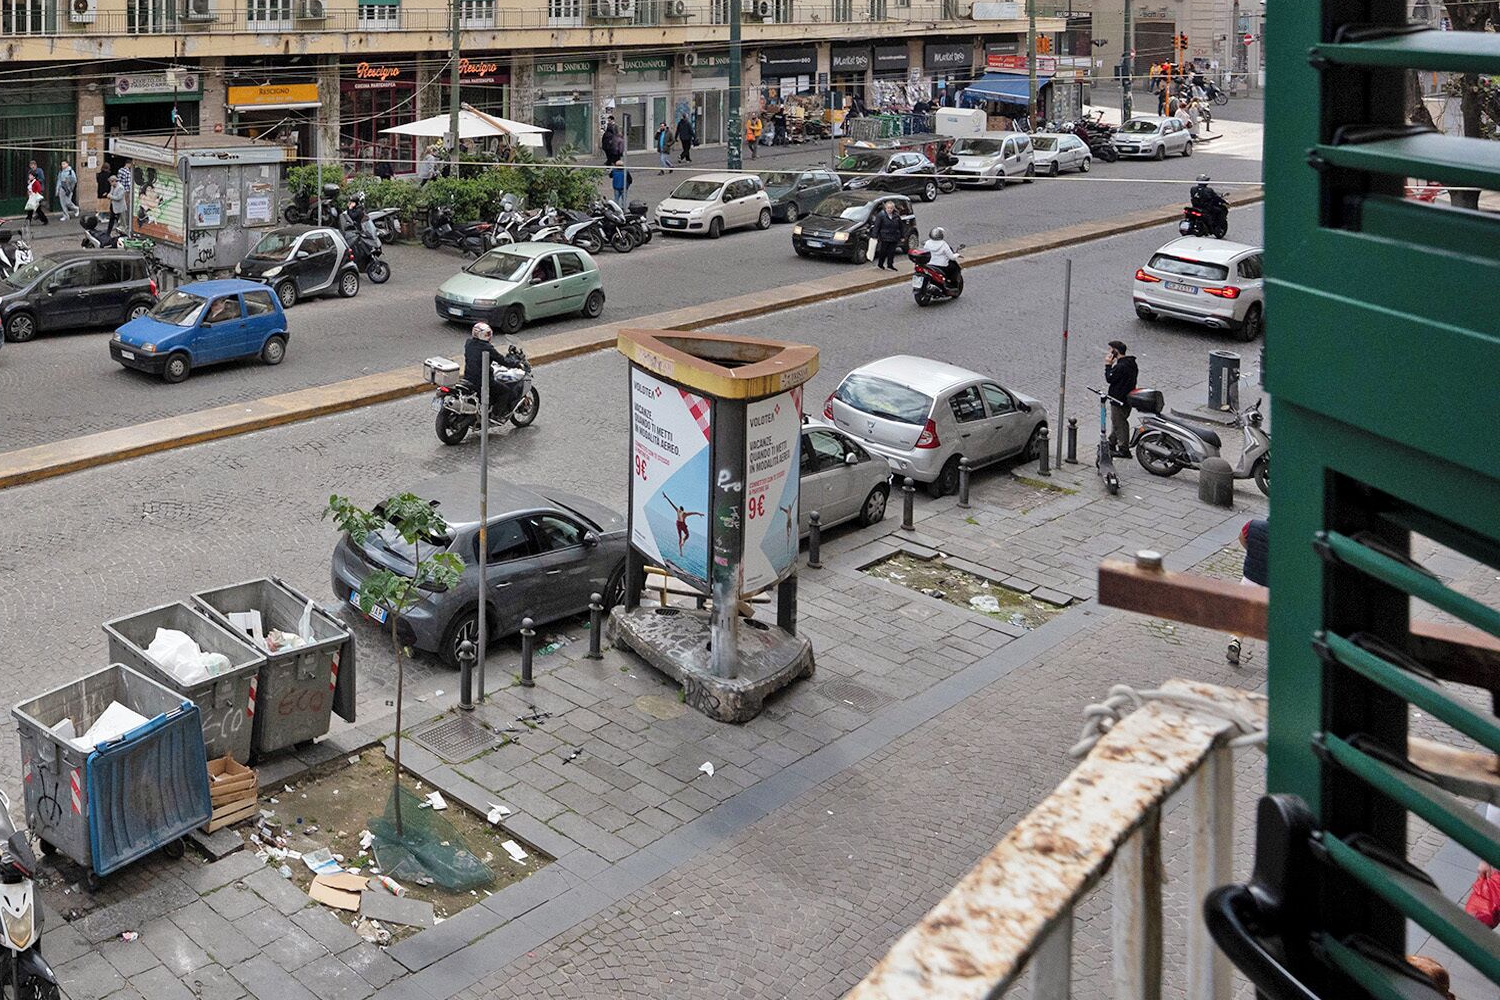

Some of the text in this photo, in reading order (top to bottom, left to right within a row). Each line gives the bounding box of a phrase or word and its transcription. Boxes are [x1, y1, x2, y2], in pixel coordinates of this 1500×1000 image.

[356, 62, 401, 81] Rescigno
[536, 63, 556, 73] INTESA
[624, 60, 643, 70] BANCO
[649, 59, 667, 68] NAPOLI
[633, 380, 655, 400] VOLOTEA
[749, 411, 775, 428] VOLOTEA
[635, 454, 648, 481] 9€
[748, 494, 765, 520] 9€
